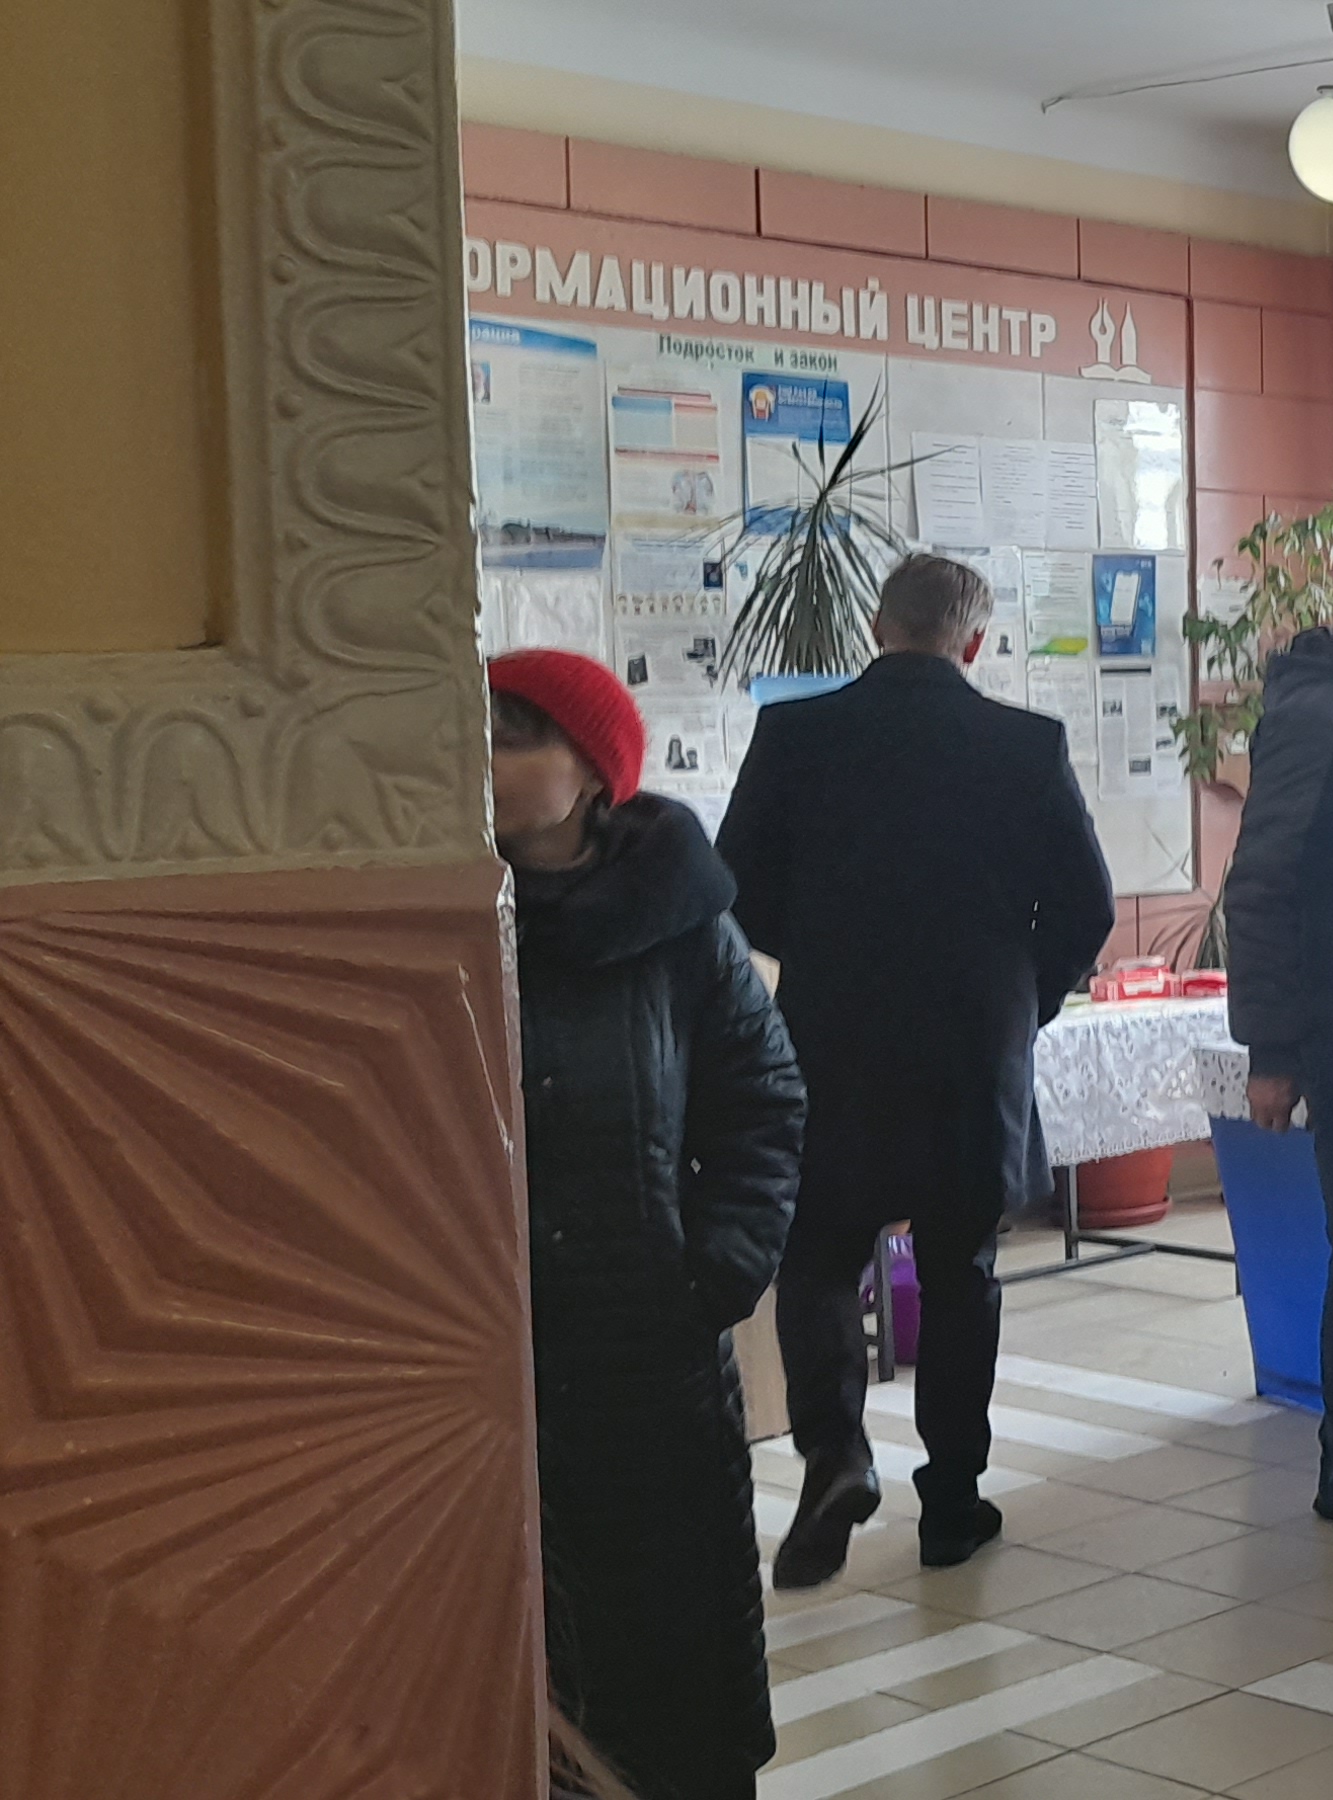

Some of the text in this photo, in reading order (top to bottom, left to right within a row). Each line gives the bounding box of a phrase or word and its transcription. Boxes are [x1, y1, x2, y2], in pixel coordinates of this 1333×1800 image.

[906, 292, 1057, 358] ЦЕНТР
[658, 334, 755, 363] Подросток
[790, 350, 838, 373] закон
